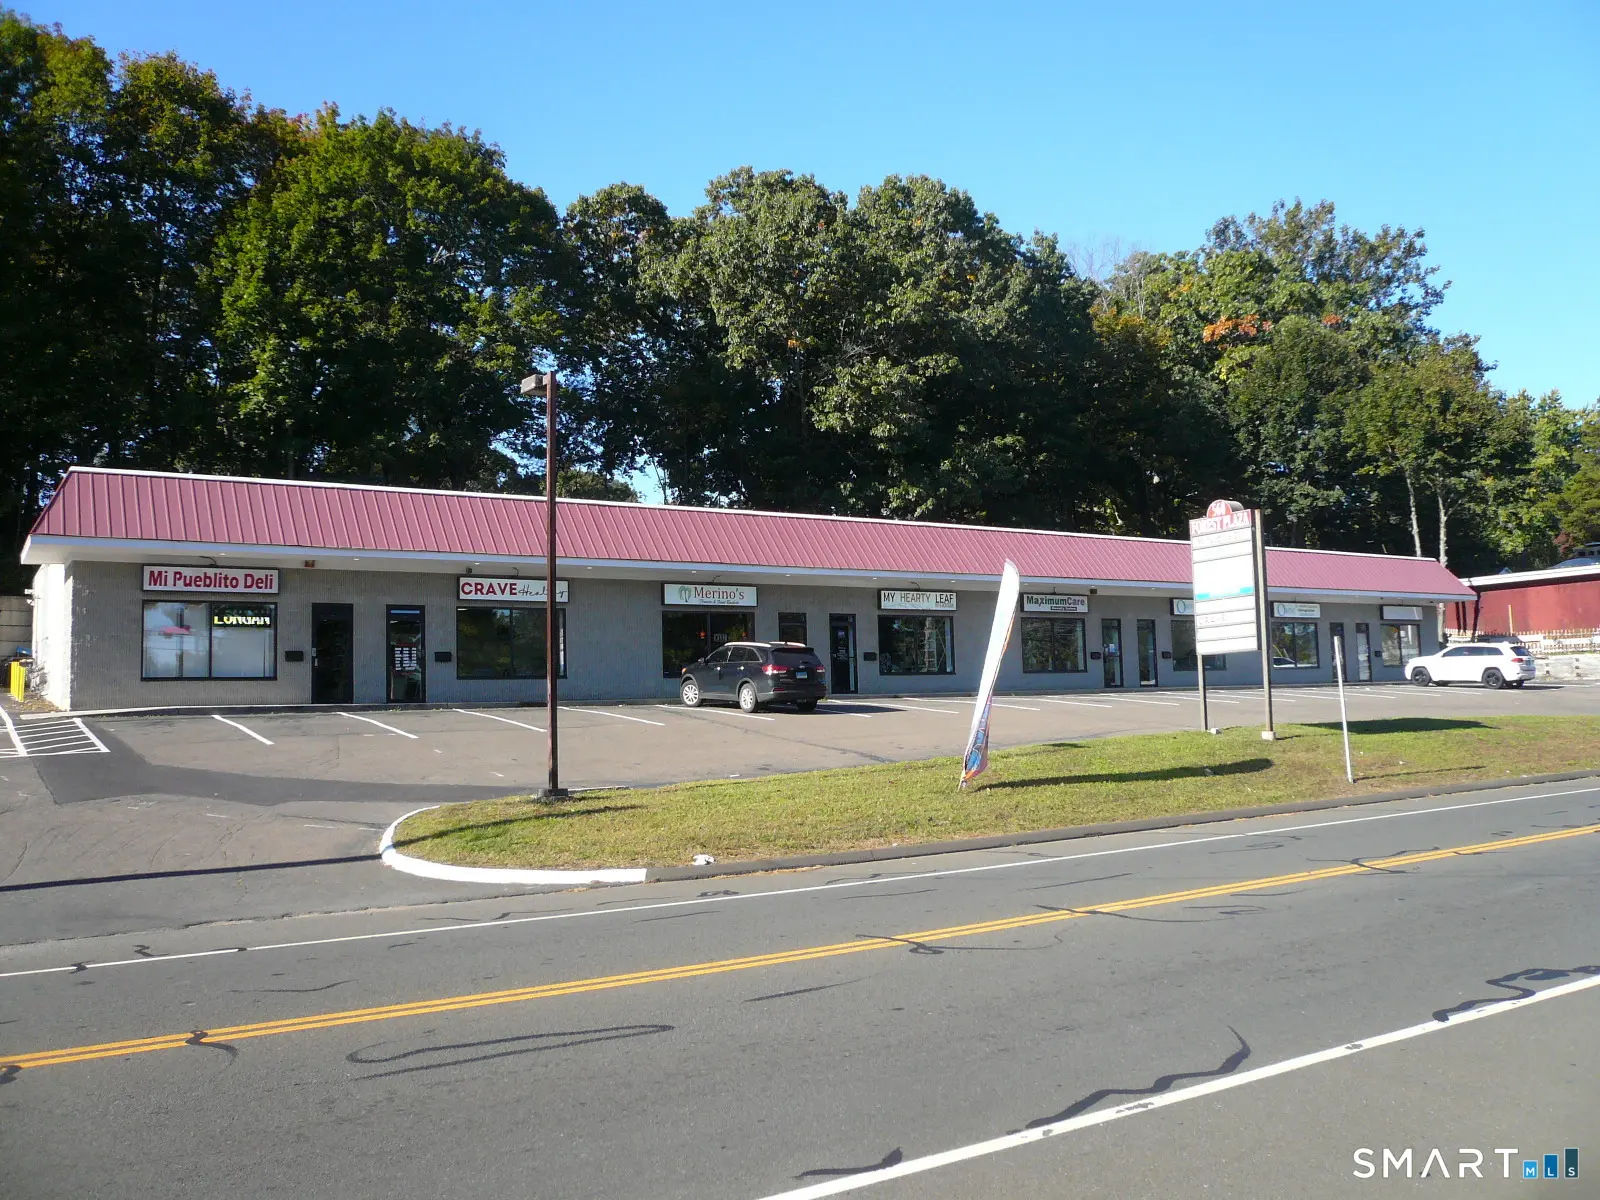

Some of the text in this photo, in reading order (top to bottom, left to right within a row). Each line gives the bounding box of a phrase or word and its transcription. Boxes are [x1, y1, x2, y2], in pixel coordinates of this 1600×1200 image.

[1222, 511, 1250, 530] PLAZA
[148, 570, 274, 590] Mi Pueblito Deli
[461, 581, 568, 599] CRAVE Healy
[694, 586, 745, 600] Merino's
[883, 592, 954, 604] MY HEARTY LEAF
[1026, 595, 1085, 607] MaximumCare
